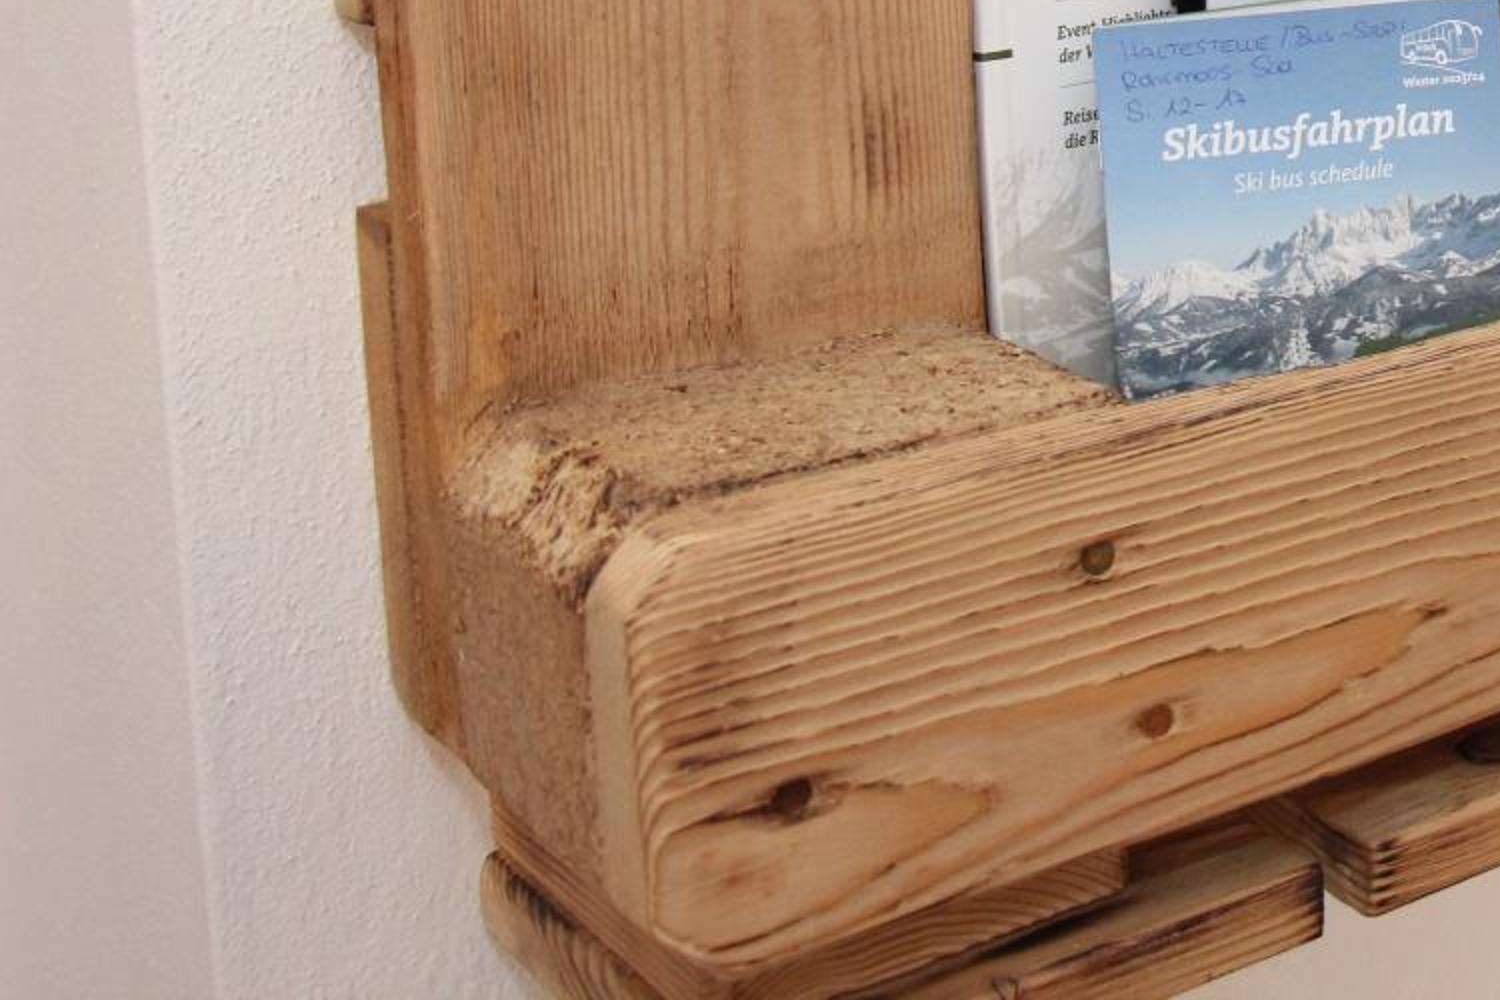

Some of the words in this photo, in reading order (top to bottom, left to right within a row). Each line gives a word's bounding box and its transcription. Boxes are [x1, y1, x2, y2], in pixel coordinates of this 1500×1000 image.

[1058, 47, 1081, 64] der
[1065, 132, 1087, 149] die
[1161, 102, 1457, 161] Skibusfahrplan
[1233, 170, 1264, 194] Ski
[1269, 165, 1304, 191] bus
[1309, 158, 1394, 186] schedule
